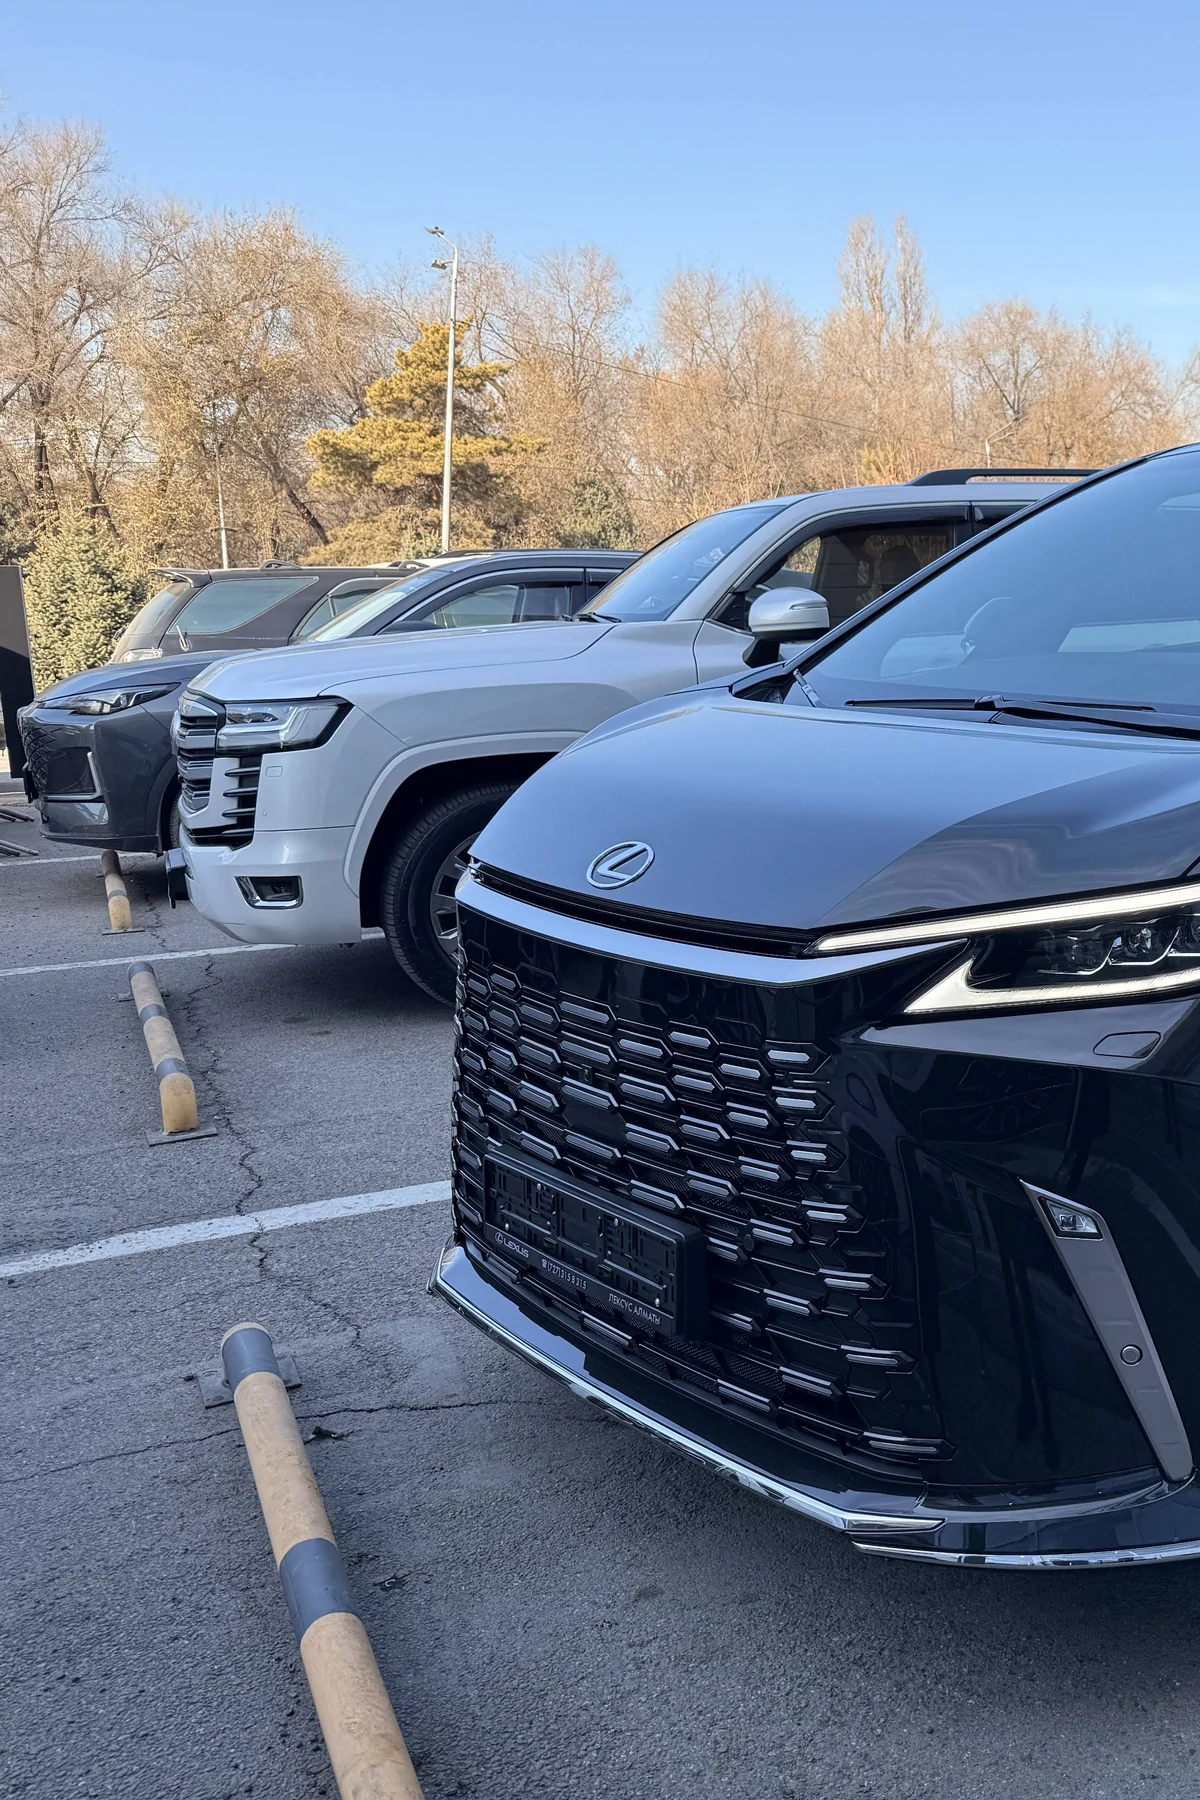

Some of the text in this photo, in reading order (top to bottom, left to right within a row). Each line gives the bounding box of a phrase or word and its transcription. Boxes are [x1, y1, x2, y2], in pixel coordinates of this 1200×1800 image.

[503, 1237, 530, 1258] LEXUS
[608, 1293, 661, 1325] ЛЕКСУС АЛМАТЫ
